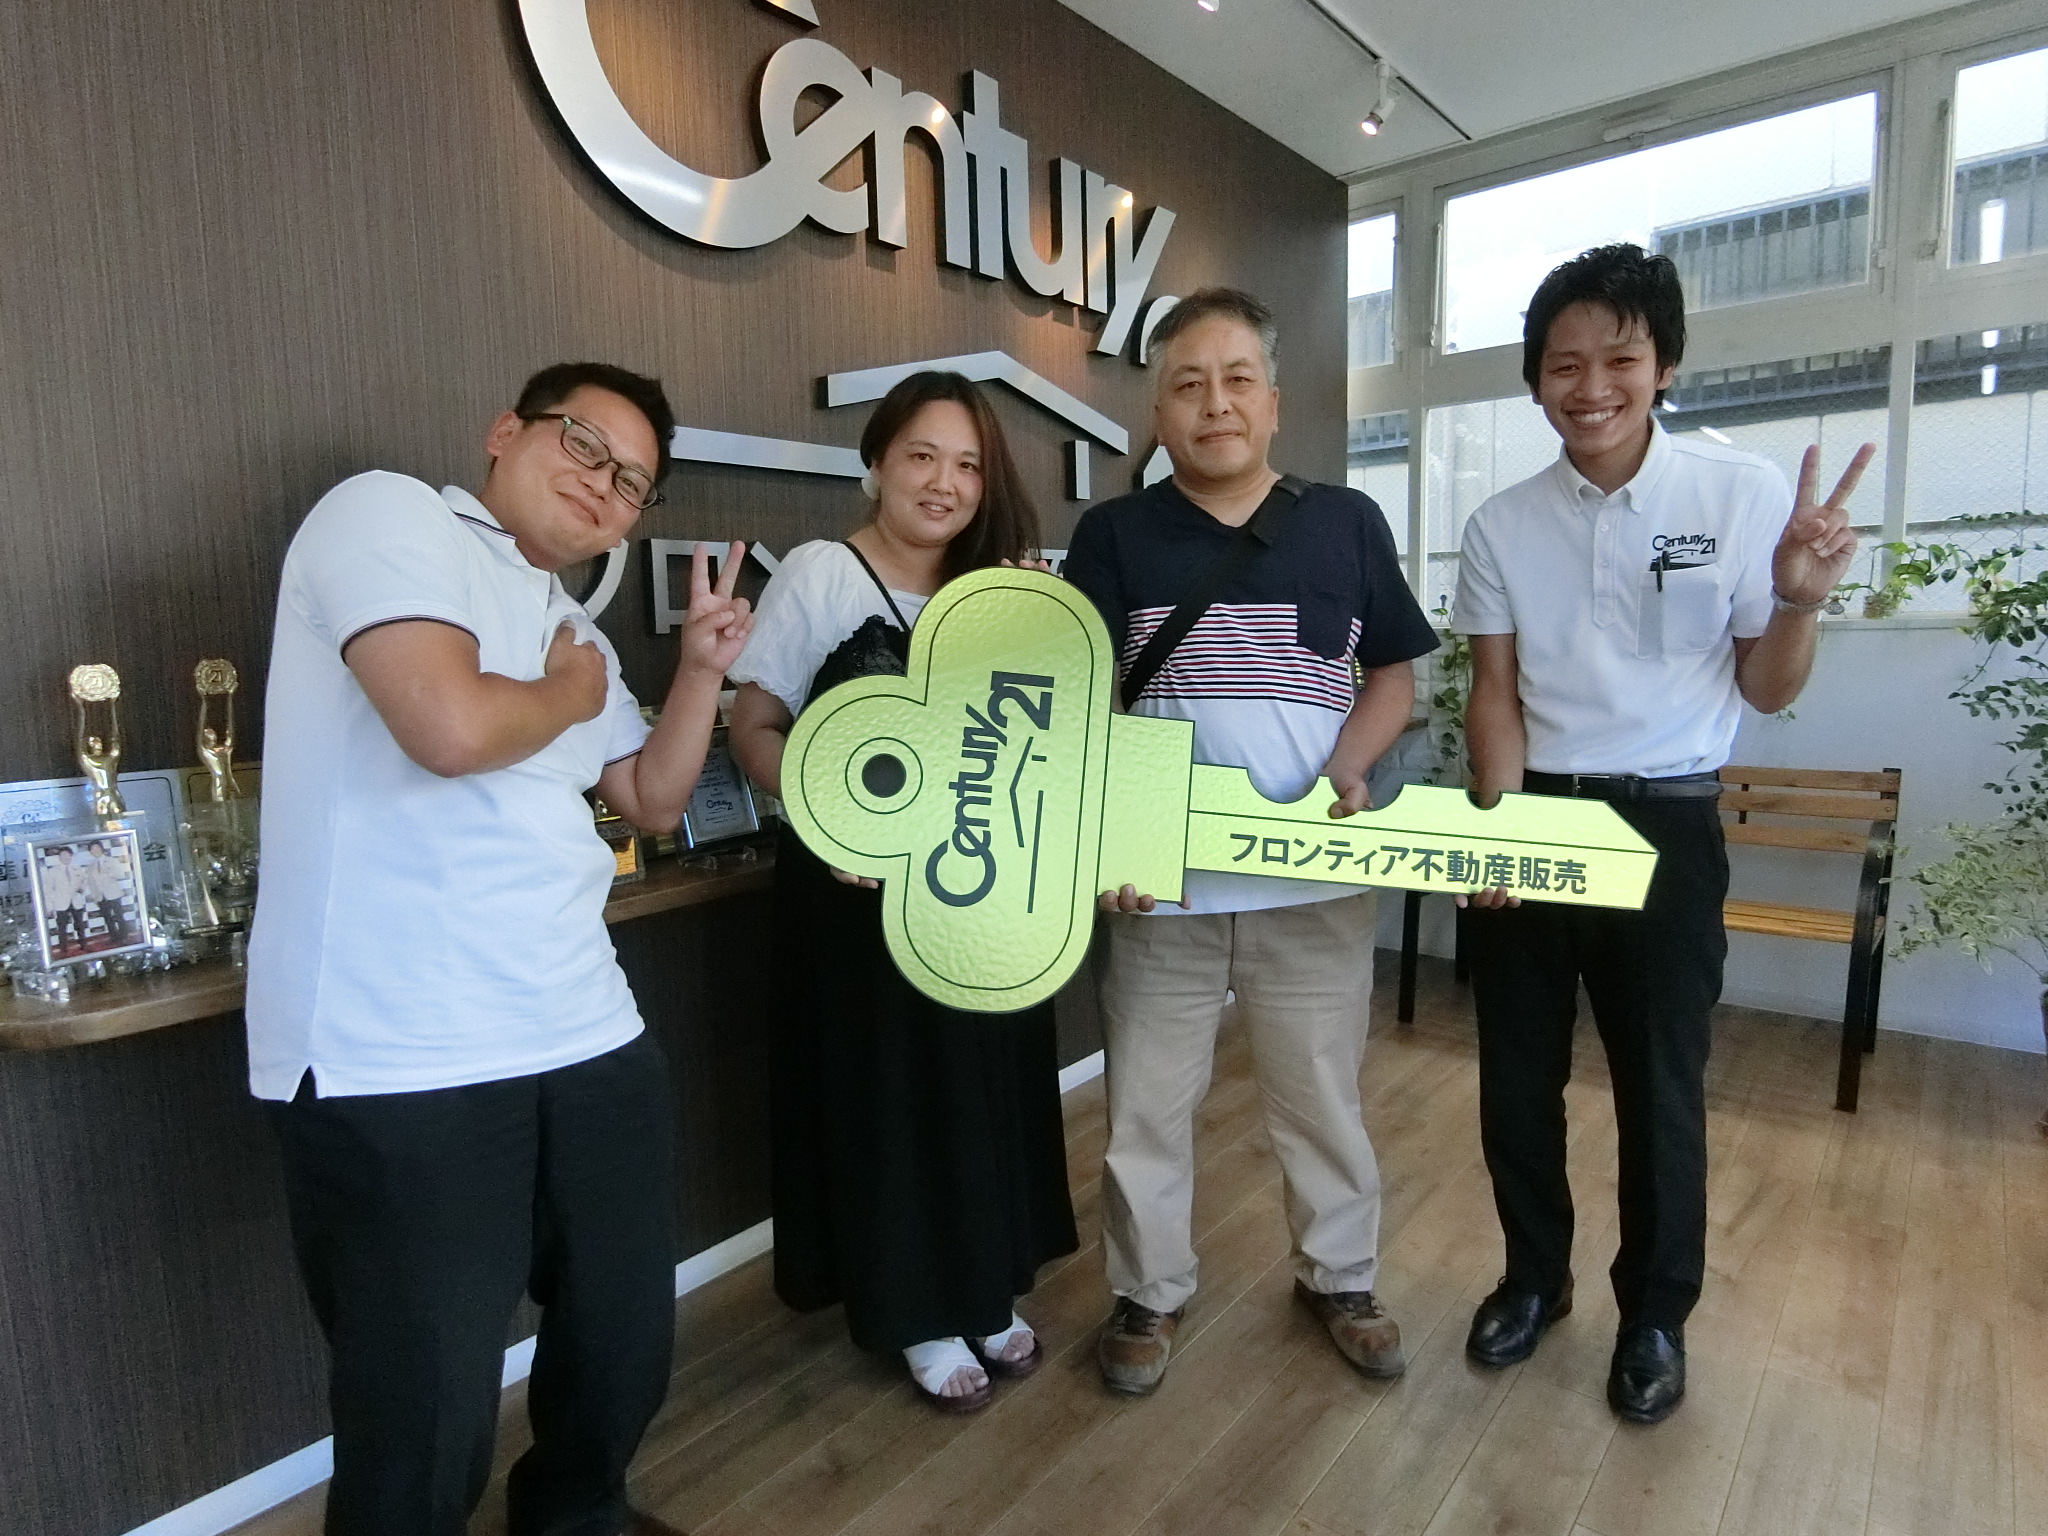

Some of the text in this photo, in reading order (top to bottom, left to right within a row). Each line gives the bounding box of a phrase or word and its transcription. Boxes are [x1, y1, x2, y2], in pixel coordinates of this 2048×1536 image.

[1229, 832, 1587, 895] フロンティア不動産販売
